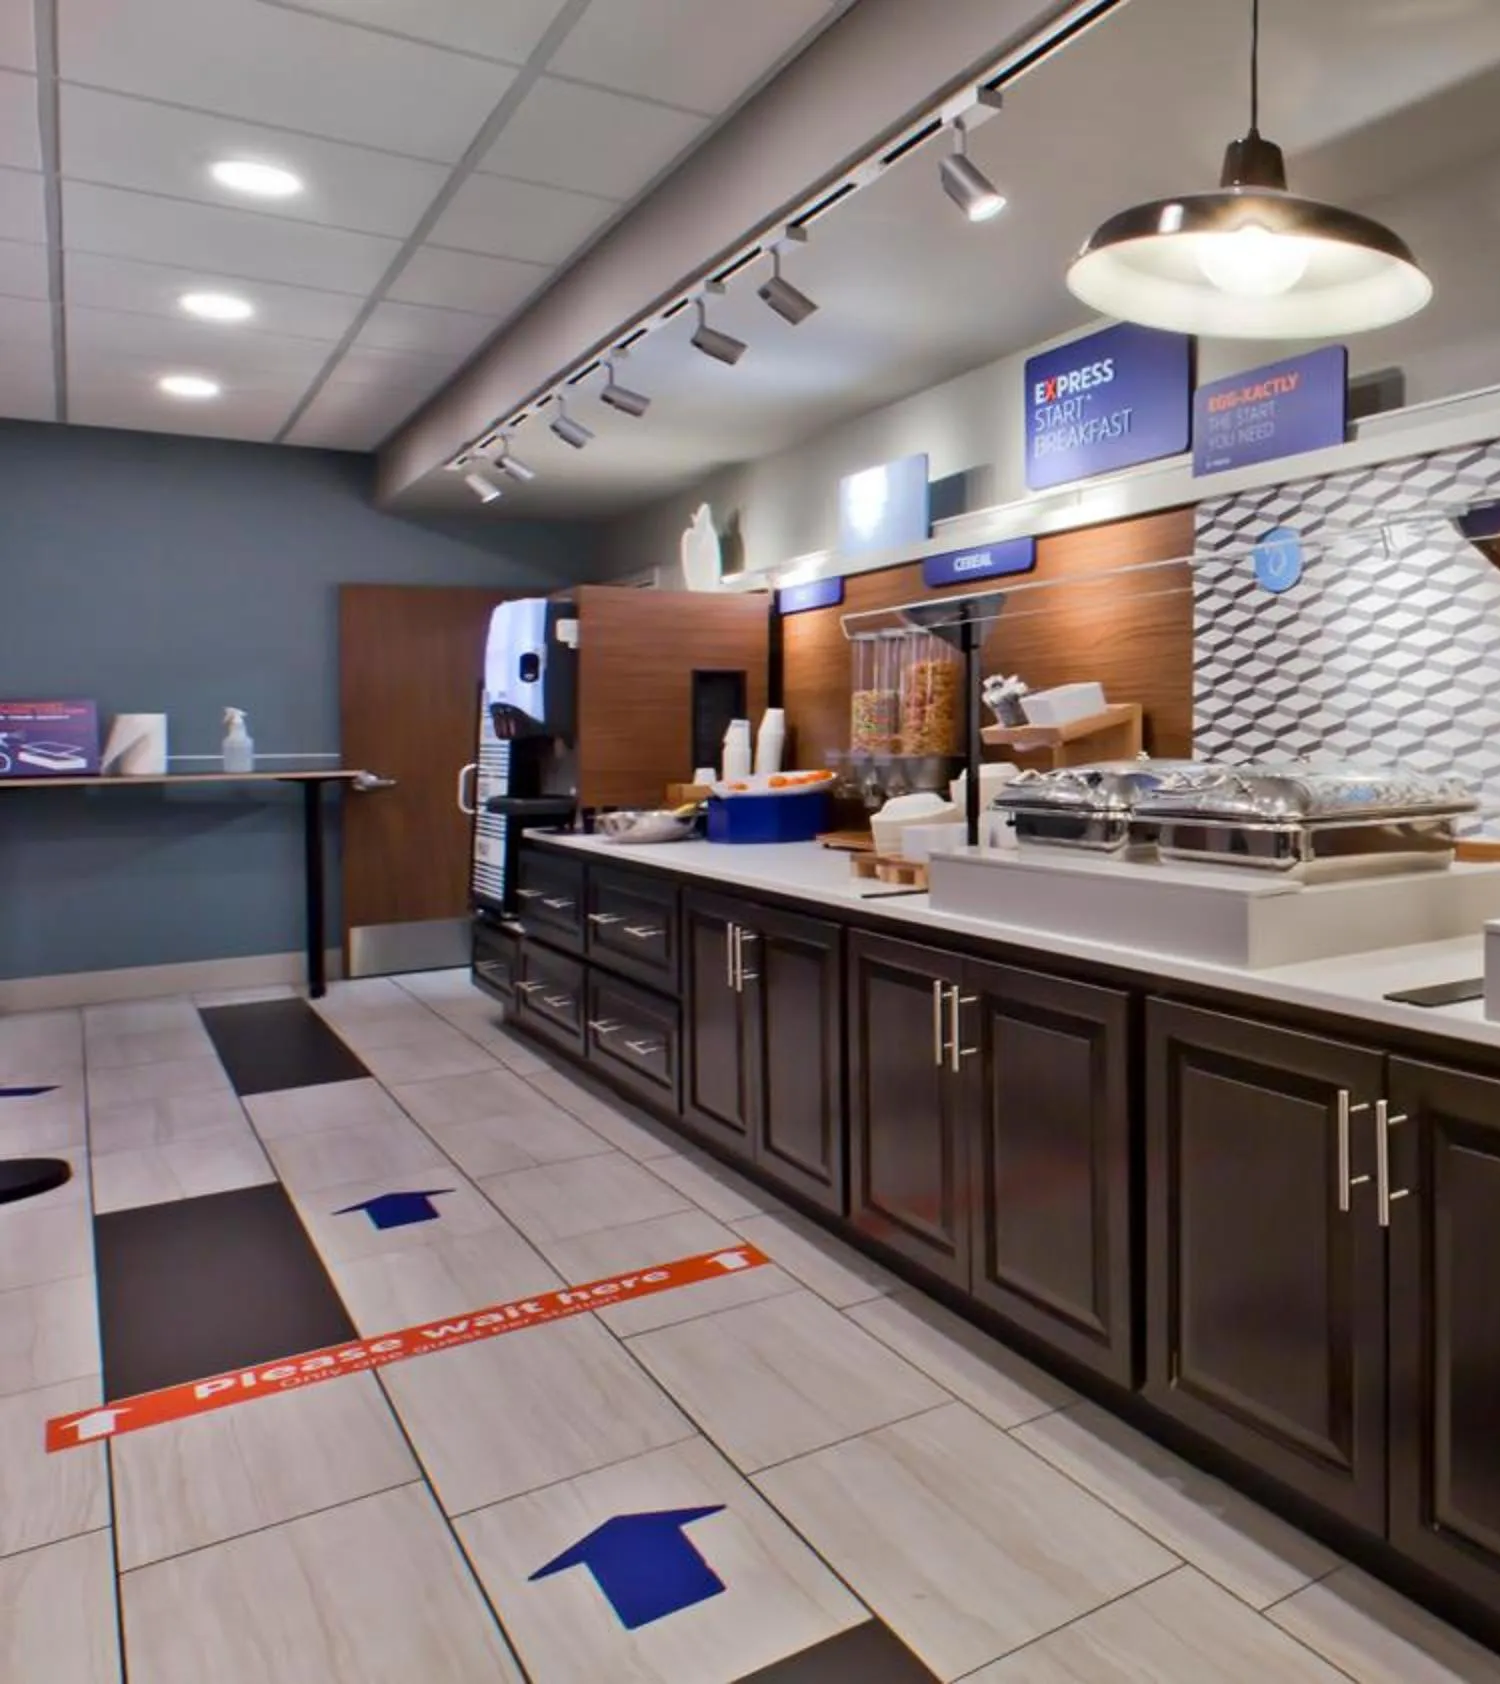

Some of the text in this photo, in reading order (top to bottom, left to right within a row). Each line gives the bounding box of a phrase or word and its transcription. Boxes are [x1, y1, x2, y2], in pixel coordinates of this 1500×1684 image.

[1034, 358, 1115, 406] EXPRESS
[1034, 406, 1134, 458] BREAKFAST
[1207, 420, 1275, 452] YOU NEED
[1208, 401, 1277, 433] THE START
[194, 1270, 671, 1399] Please wait here
[280, 1367, 343, 1389] Only
[352, 1351, 404, 1370] one
